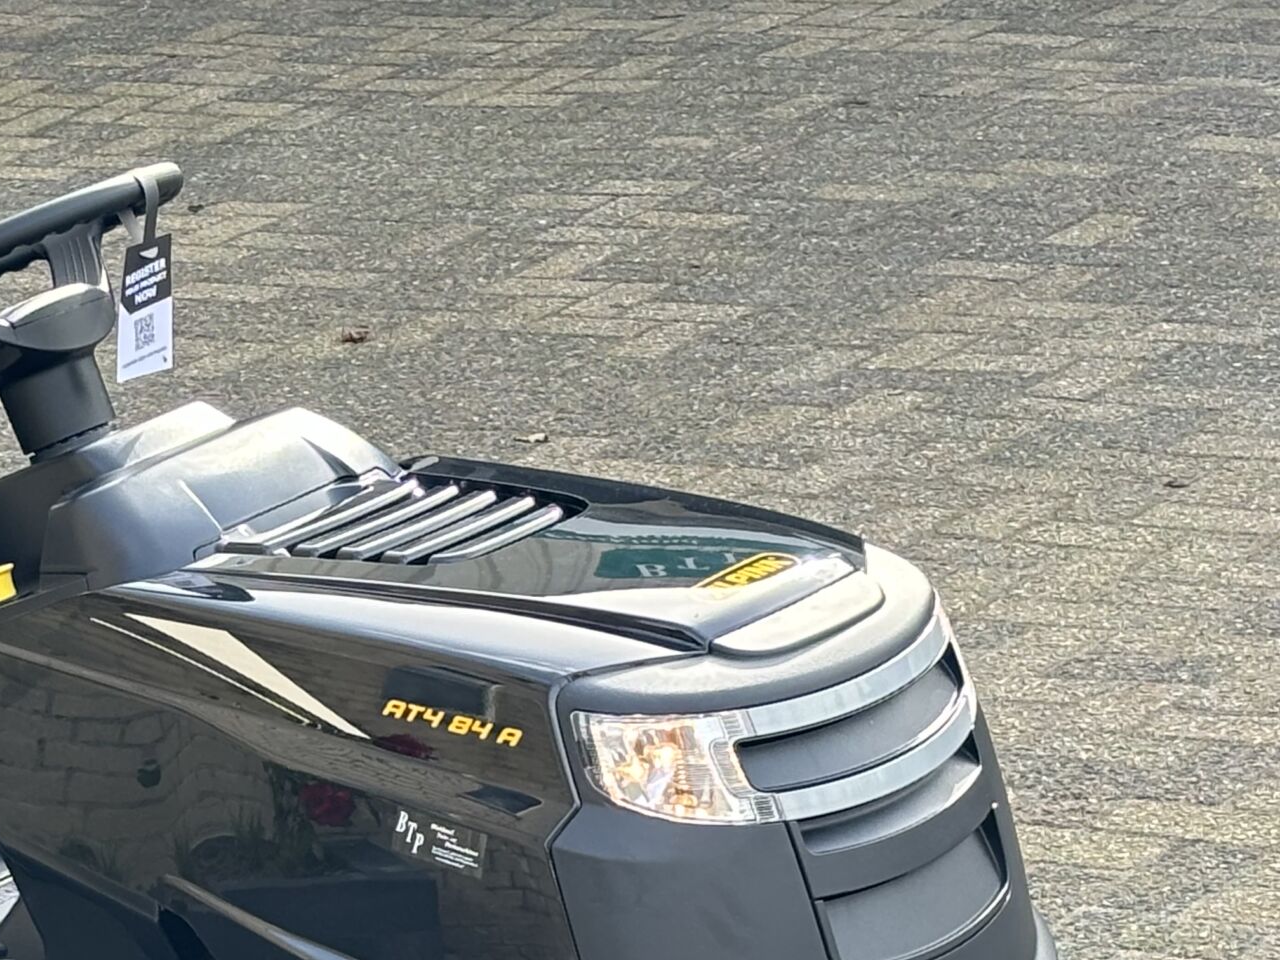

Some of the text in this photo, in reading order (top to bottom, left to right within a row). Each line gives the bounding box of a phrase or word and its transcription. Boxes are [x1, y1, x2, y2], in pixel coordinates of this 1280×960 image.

[125, 257, 167, 287] REGISTER
[134, 284, 158, 305] NOW
[381, 699, 523, 748] AT4 84 A
[395, 810, 425, 854] BTP
